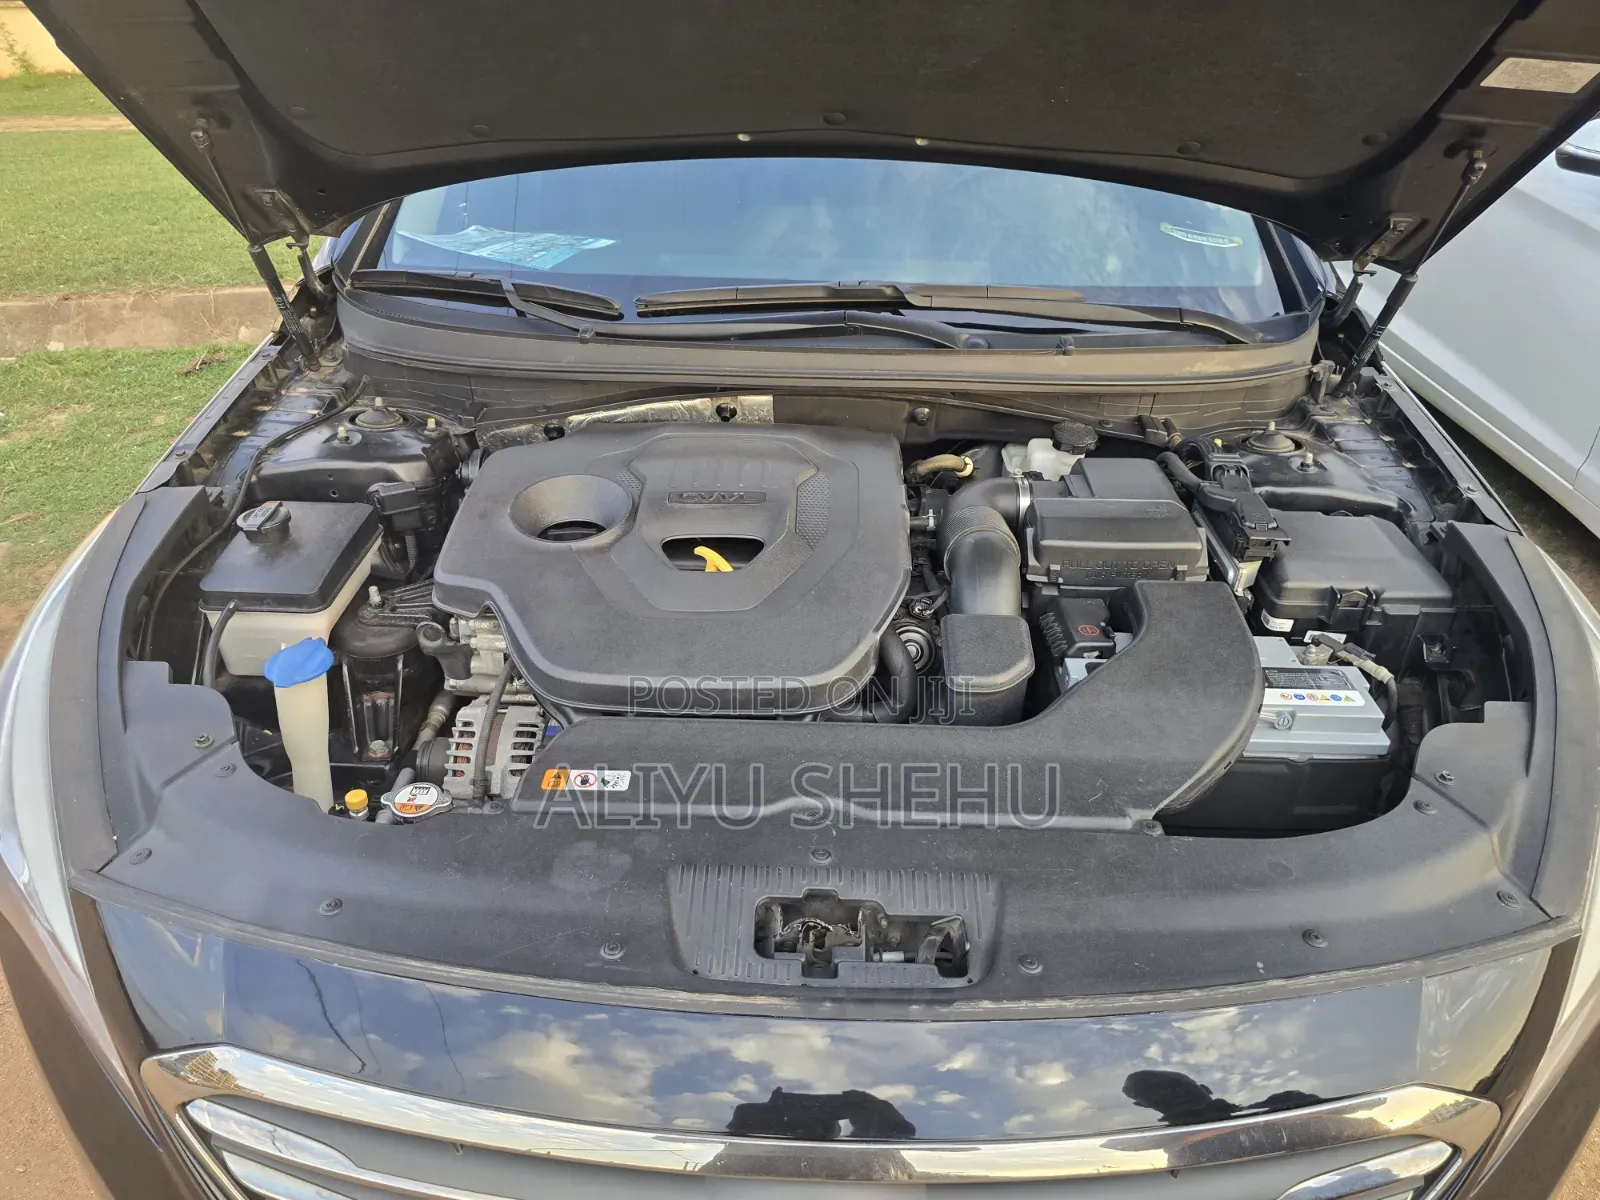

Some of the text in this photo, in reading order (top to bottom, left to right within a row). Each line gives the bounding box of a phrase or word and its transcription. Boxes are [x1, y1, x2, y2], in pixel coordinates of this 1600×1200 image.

[1373, 325, 1386, 337] LH
[1061, 559, 1177, 570] PULL OUT TO OPEN
